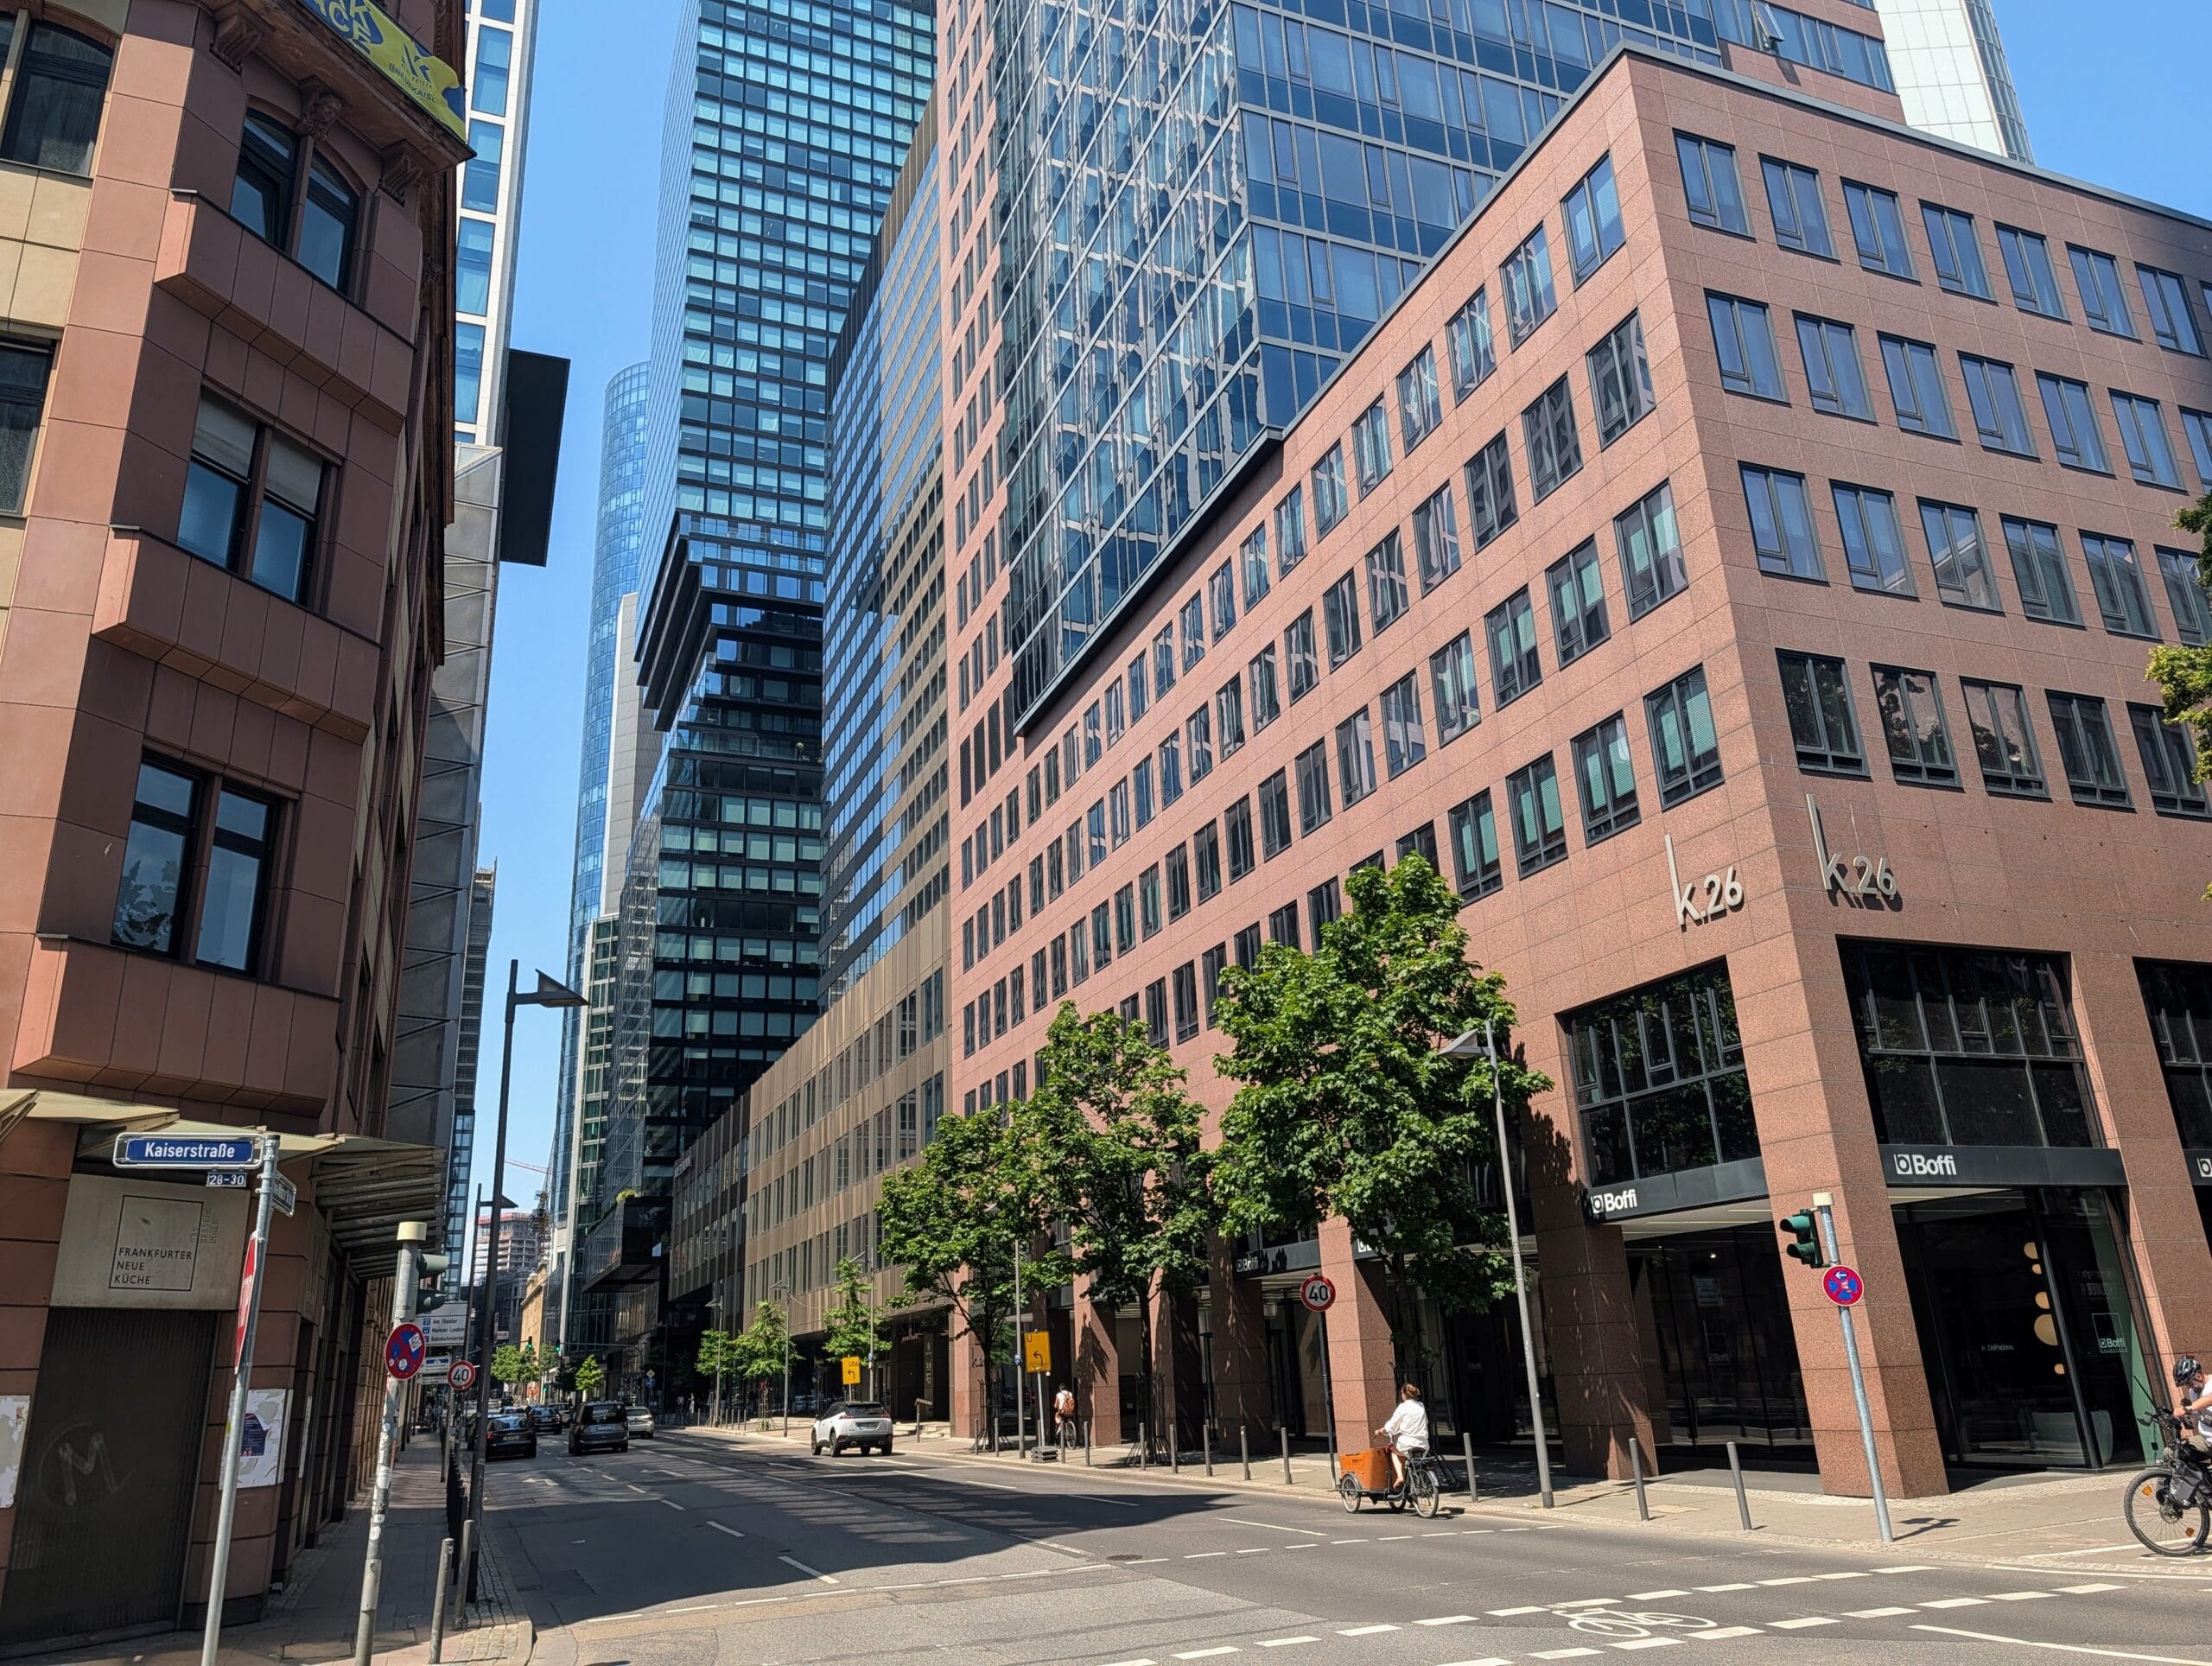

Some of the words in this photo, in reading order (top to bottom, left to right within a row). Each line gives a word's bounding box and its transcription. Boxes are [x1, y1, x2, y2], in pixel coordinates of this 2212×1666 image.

[144, 1141, 235, 1158] Kaiserstraße
[1912, 1154, 1957, 1175] Boffi
[209, 1174, 245, 1186] 28-30
[1604, 1189, 1637, 1211] Boffi
[118, 1247, 192, 1260] FRANKFURTER
[117, 1261, 144, 1271] NEUE
[114, 1274, 151, 1285] KÜCHE
[1309, 1286, 1328, 1301] 40
[453, 1369, 470, 1382] 40
